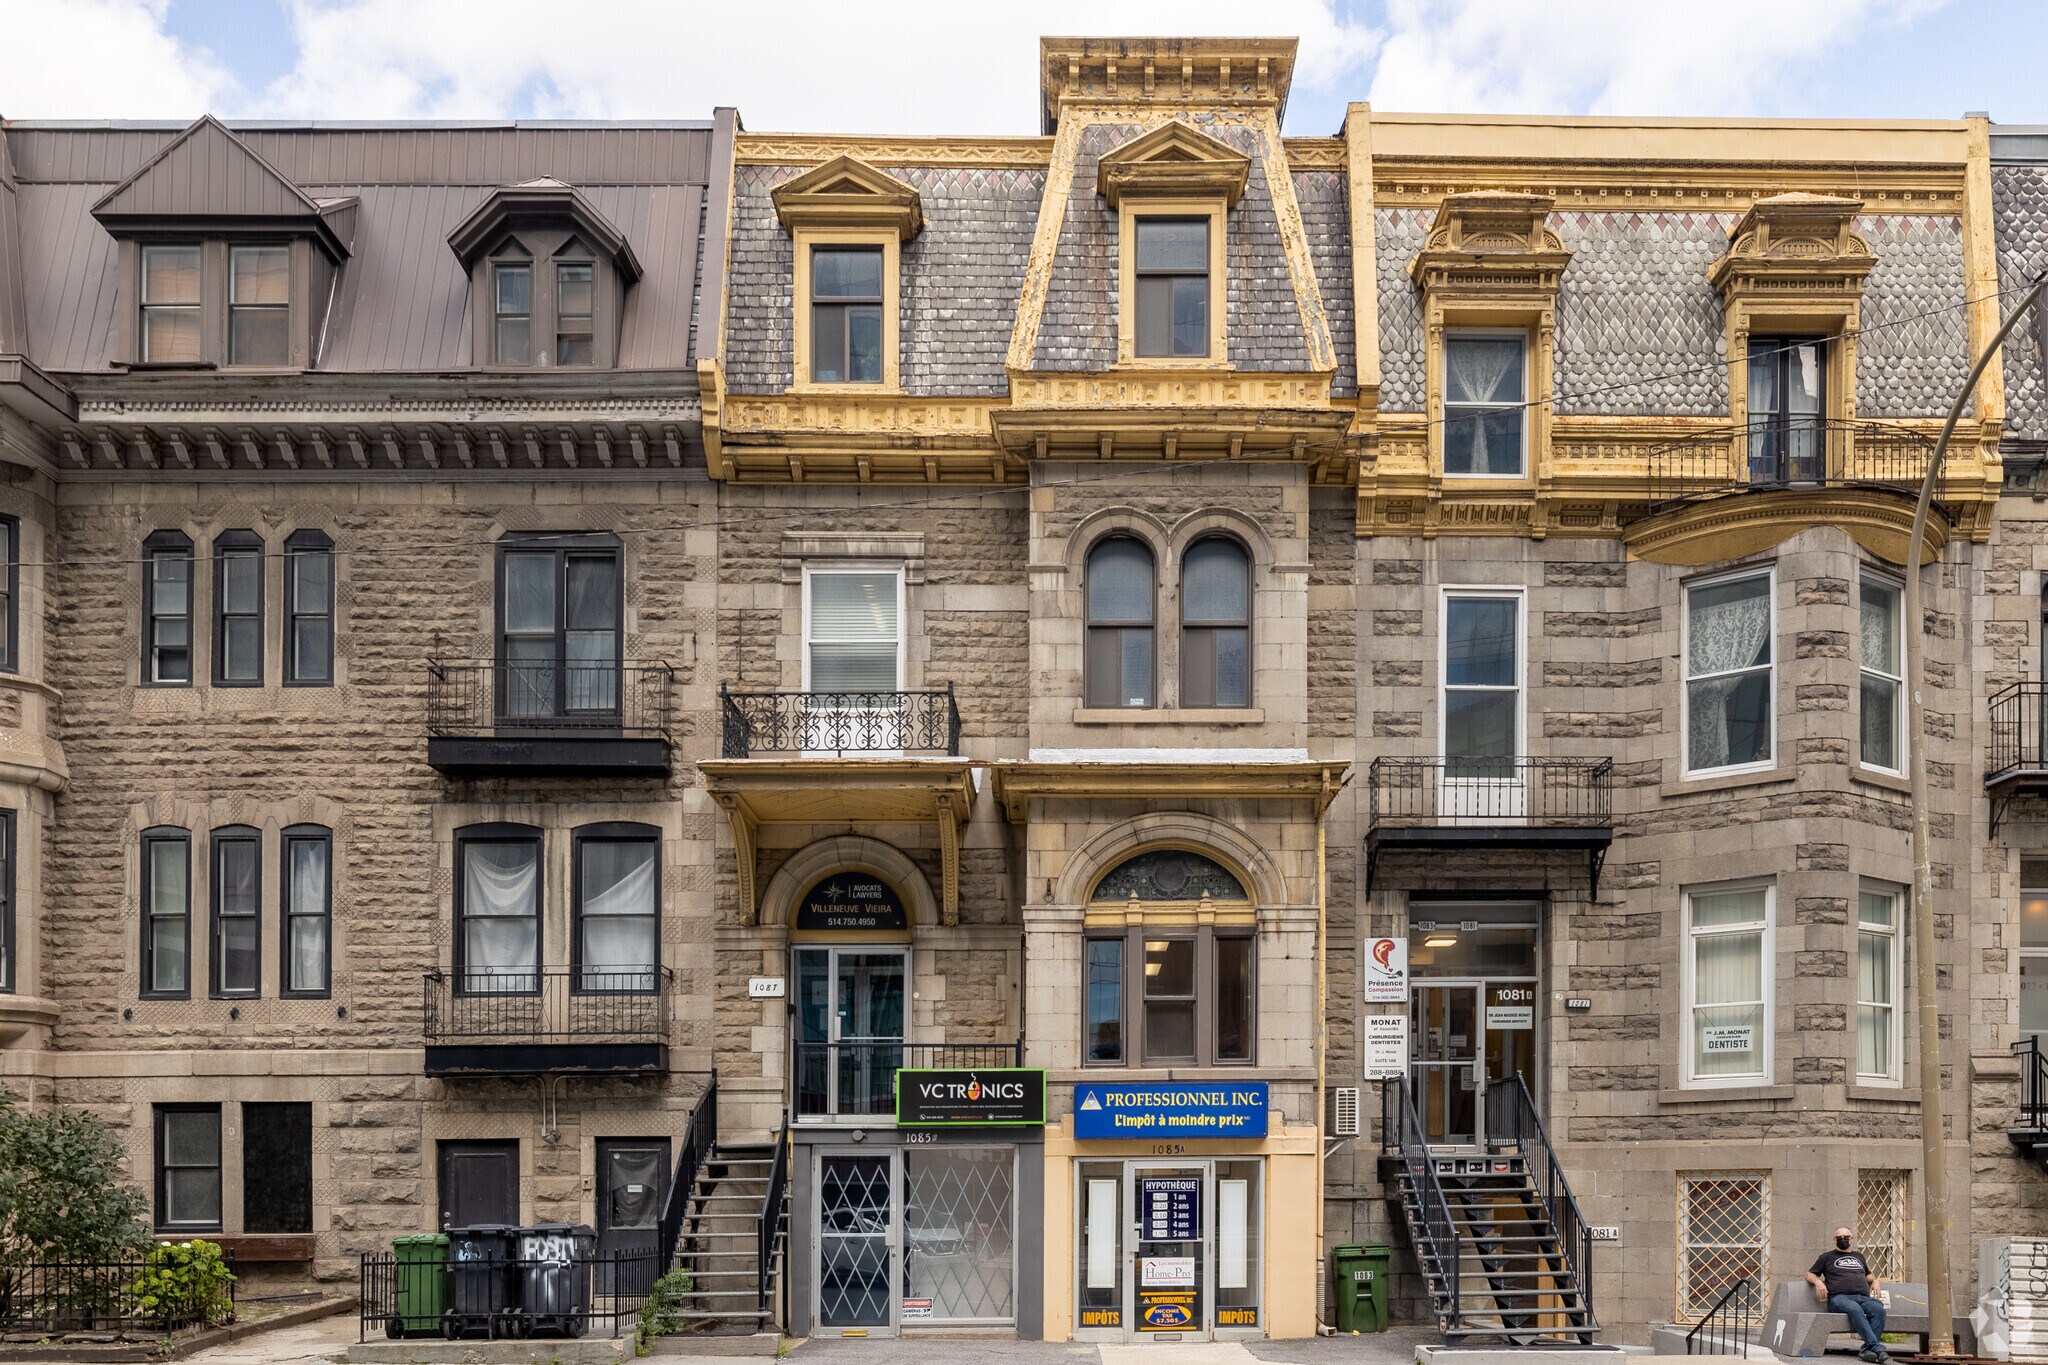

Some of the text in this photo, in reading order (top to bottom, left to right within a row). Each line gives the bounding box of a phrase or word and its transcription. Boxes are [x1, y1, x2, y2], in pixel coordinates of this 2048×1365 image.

[811, 903, 892, 912] VILLENEUVE VIEIRA
[828, 918, 876, 926] 514.750.4950
[755, 983, 778, 991] 1087
[1368, 979, 1403, 987] Présence
[1497, 989, 1525, 1000] 1081
[1708, 1040, 1748, 1049] DENTISTE
[1105, 1092, 1263, 1107] PROFESSIONNEL INC.
[1158, 1113, 1166, 1126] à
[1168, 1113, 1216, 1126] moindre
[1219, 1114, 1244, 1128] prix
[1145, 1180, 1196, 1190] HYPOTHÈQUE
[1592, 1228, 1610, 1239] 081
[1145, 1267, 1191, 1278] Home-Pro
[1082, 1309, 1120, 1325] IMPÔTS
[1218, 1308, 1256, 1324] IMPÔTS
